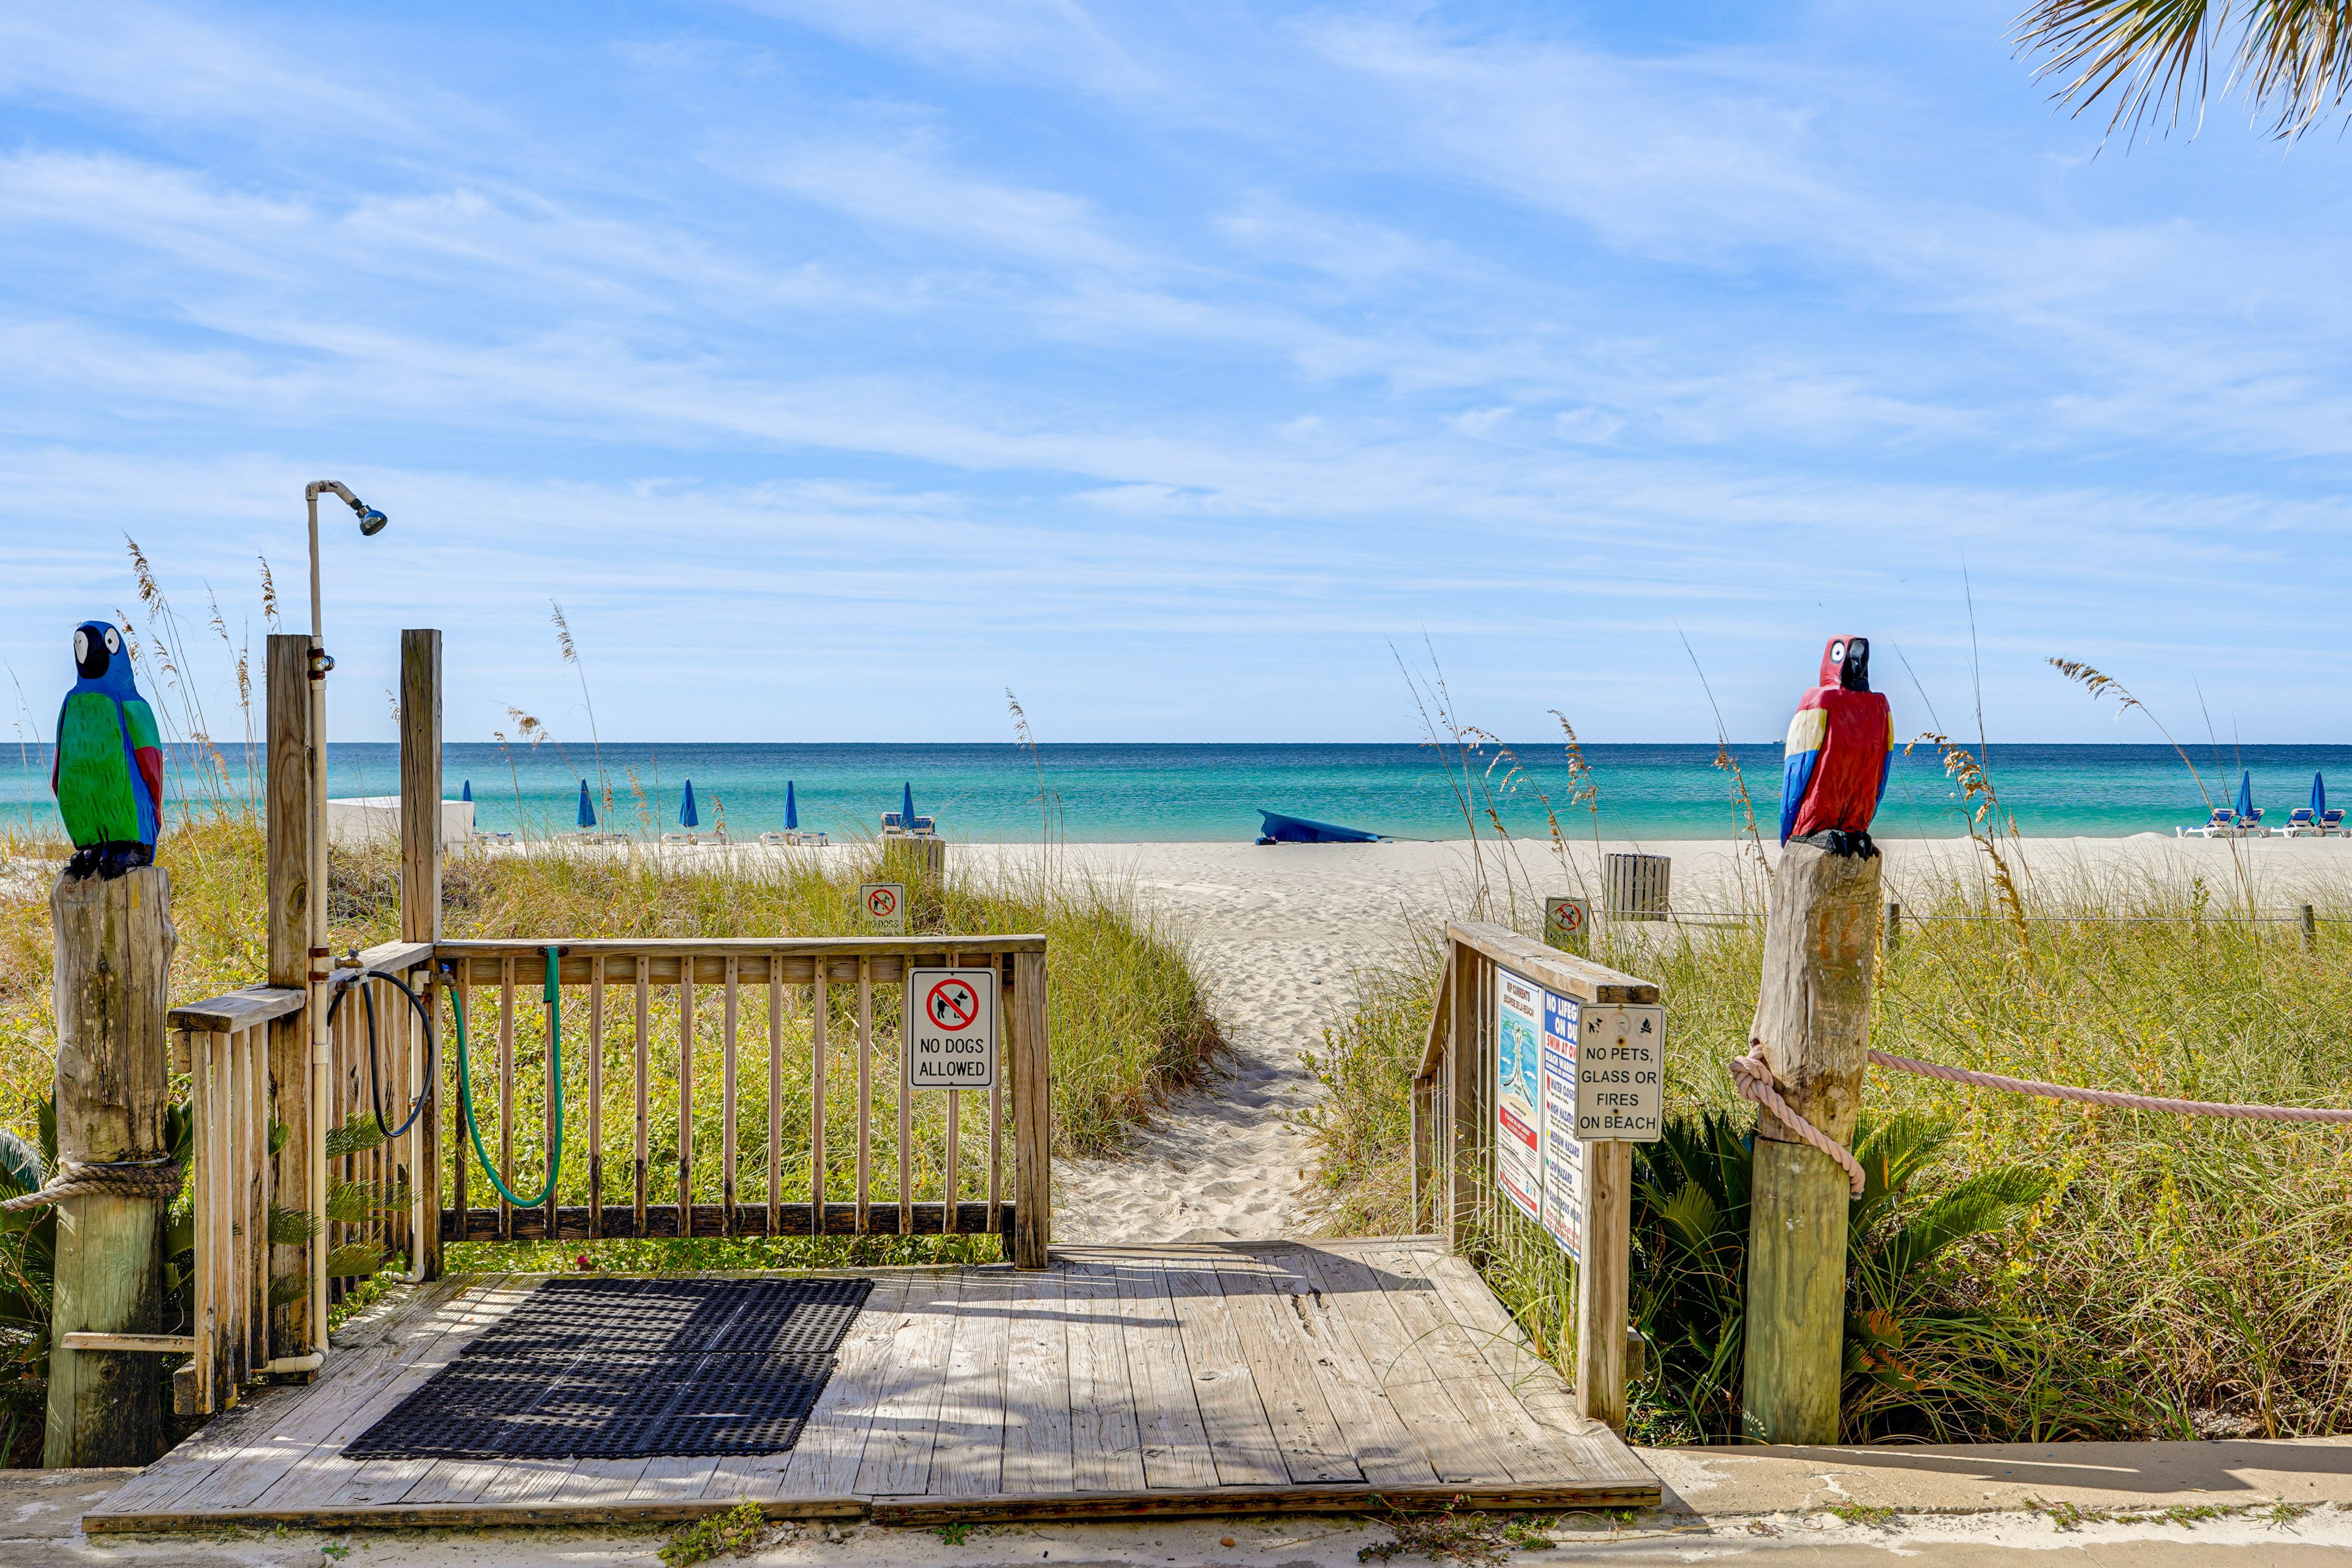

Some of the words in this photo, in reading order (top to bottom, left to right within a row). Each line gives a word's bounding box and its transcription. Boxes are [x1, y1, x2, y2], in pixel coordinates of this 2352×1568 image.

[1513, 984, 1530, 1002] CURRENTS
[1547, 993, 1556, 1013] NO
[1558, 998, 1578, 1022] LIFEG
[1555, 1016, 1566, 1037] ON
[921, 1038, 940, 1053] NO
[945, 1038, 984, 1053] DOGS
[1547, 1034, 1560, 1052] SWIM
[1561, 1041, 1568, 1056] AT
[1545, 1050, 1558, 1066] BEACH
[1586, 1047, 1607, 1060] NO
[1611, 1047, 1653, 1063] PETS,
[919, 1061, 985, 1076] ALLOWED
[1581, 1070, 1630, 1083] GLASS
[1635, 1071, 1657, 1084] OR
[1551, 1077, 1562, 1095] WATER
[1597, 1093, 1638, 1106] FIRES
[1550, 1101, 1559, 1116] HIGH
[1559, 1107, 1574, 1126] HAZARD
[1580, 1116, 1599, 1129] ON
[1604, 1116, 1656, 1129] BEACH
[1564, 1139, 1580, 1158] HAZARD
[1558, 1166, 1572, 1185] HAZARD
